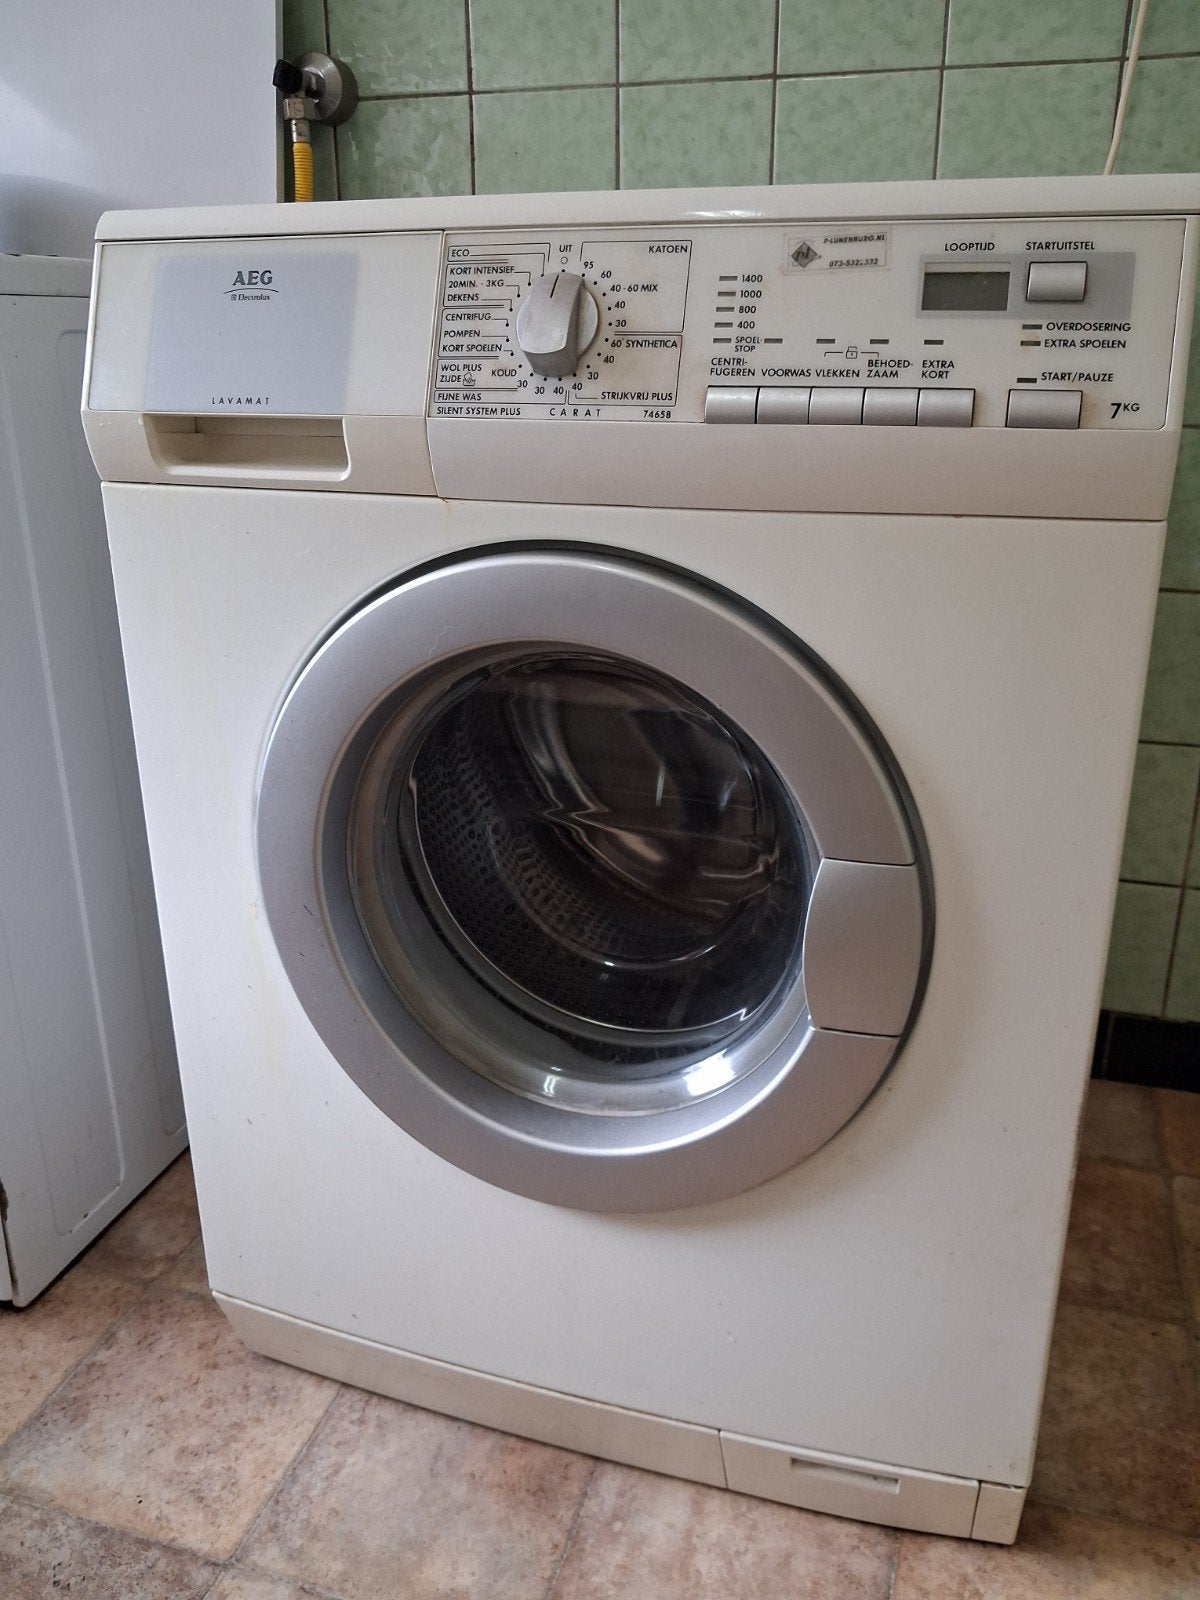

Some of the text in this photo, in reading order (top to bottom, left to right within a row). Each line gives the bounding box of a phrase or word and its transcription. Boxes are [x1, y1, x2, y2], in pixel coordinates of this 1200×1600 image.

[559, 244, 573, 253] UIT
[648, 245, 688, 253] KATOEN
[944, 242, 995, 251] LOOPTIJD
[1025, 241, 1096, 250] STARTUITSTEL
[451, 248, 470, 257] ECO
[583, 261, 594, 269] 95
[829, 258, 879, 268] 073-532332
[450, 266, 515, 275] KORT INTENSIEF
[600, 270, 612, 279] 60
[232, 269, 273, 286] AEG
[742, 275, 763, 283] 1400
[486, 279, 504, 288] 3KG
[610, 284, 621, 293] 40
[627, 284, 639, 293] 60
[640, 284, 658, 292] MIX
[238, 293, 271, 301] Electrolux
[447, 293, 479, 302] DEKENS
[740, 290, 762, 299] 1000
[614, 300, 626, 309] 40
[738, 306, 757, 314] 800
[615, 319, 627, 328] 30
[737, 321, 755, 329] 400
[1046, 322, 1132, 332] OVERDOSERING
[443, 330, 481, 338] POMPEN
[610, 339, 678, 348] 60 SYNTHETICA
[735, 336, 763, 344] SPOEL-
[1044, 339, 1126, 349] EXTRA SPOELEN
[442, 344, 502, 353] KORT SPOELEN
[734, 345, 756, 353] STOP
[603, 355, 615, 364] 40
[711, 357, 748, 366] CENTRI-
[867, 360, 914, 368] BEHOED-
[441, 363, 482, 372] WOL PLUS
[922, 360, 955, 369] EXTRA
[491, 369, 517, 377] KOUD
[587, 372, 599, 380] 30
[710, 368, 756, 376] FUGEREN
[761, 368, 812, 377] VOORWAS
[815, 369, 860, 378] VLEKKEN
[866, 370, 899, 378] ZAAM
[921, 370, 950, 379] KORT
[1041, 372, 1114, 382] START/PAUZE
[517, 379, 528, 388] 30
[571, 382, 583, 391] 40
[534, 386, 545, 395] 30
[553, 386, 564, 395] 40
[462, 393, 482, 401] WAS
[601, 391, 673, 401] STRIJKVRIJ PLUS
[212, 397, 270, 405] LAVAMAT
[436, 407, 521, 416] SILENT SYSTEM PLUS
[643, 410, 671, 419] 74658
[1110, 403, 1140, 419] 7 KG
